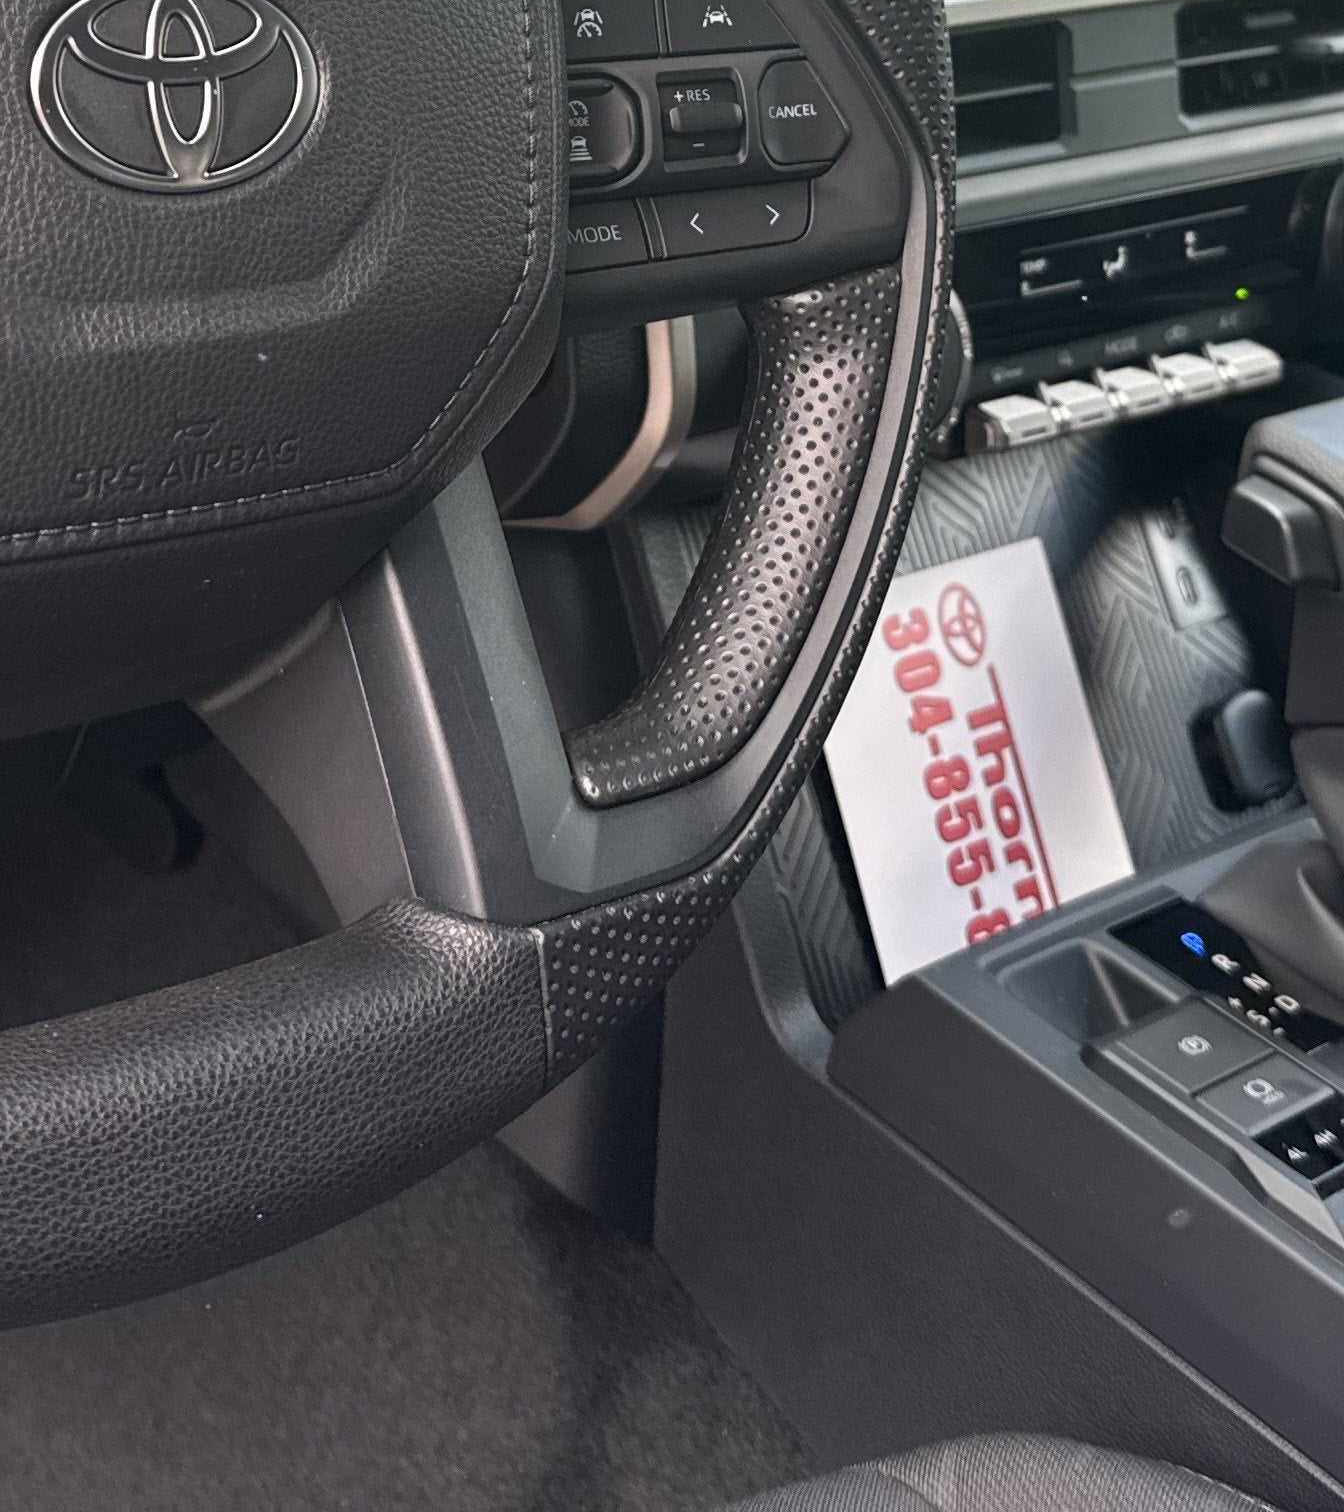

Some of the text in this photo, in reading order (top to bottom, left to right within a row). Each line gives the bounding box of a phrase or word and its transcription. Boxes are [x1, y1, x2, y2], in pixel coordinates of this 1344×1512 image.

[767, 103, 818, 120] CANCEL
[160, 436, 304, 487] AIRBAG
[1210, 953, 1241, 976] R
